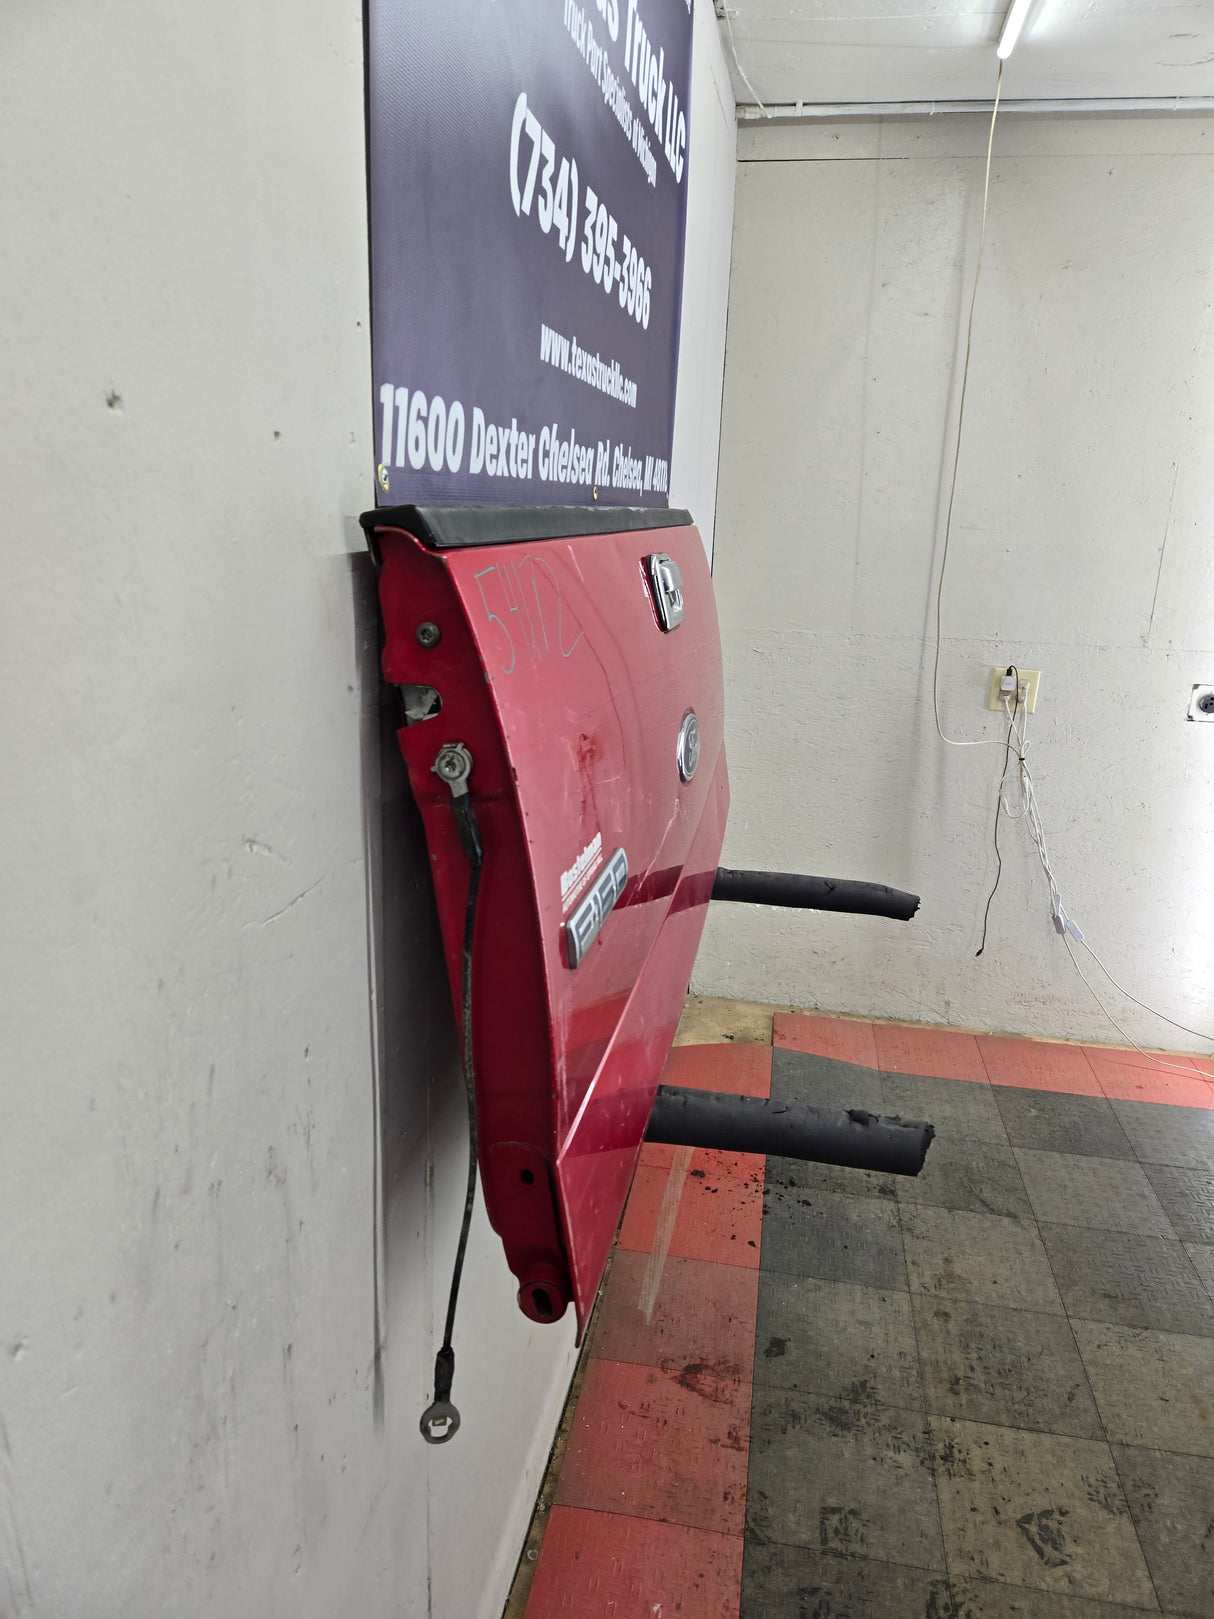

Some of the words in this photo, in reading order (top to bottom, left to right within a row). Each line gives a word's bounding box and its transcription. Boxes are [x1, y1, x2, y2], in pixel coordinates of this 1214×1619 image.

[624, 0, 666, 144] Truck
[665, 80, 686, 184] LLC
[509, 92, 579, 263] (734)
[581, 186, 652, 330] 395-3966
[380, 382, 465, 473] 11600
[469, 406, 536, 479] Dexter
[538, 423, 595, 485] Chelsea
[595, 439, 610, 487] Rd.
[612, 443, 643, 497] Chelsea,
[643, 455, 654, 491] MI
[540, 323, 637, 408] www.texastruckllc.com
